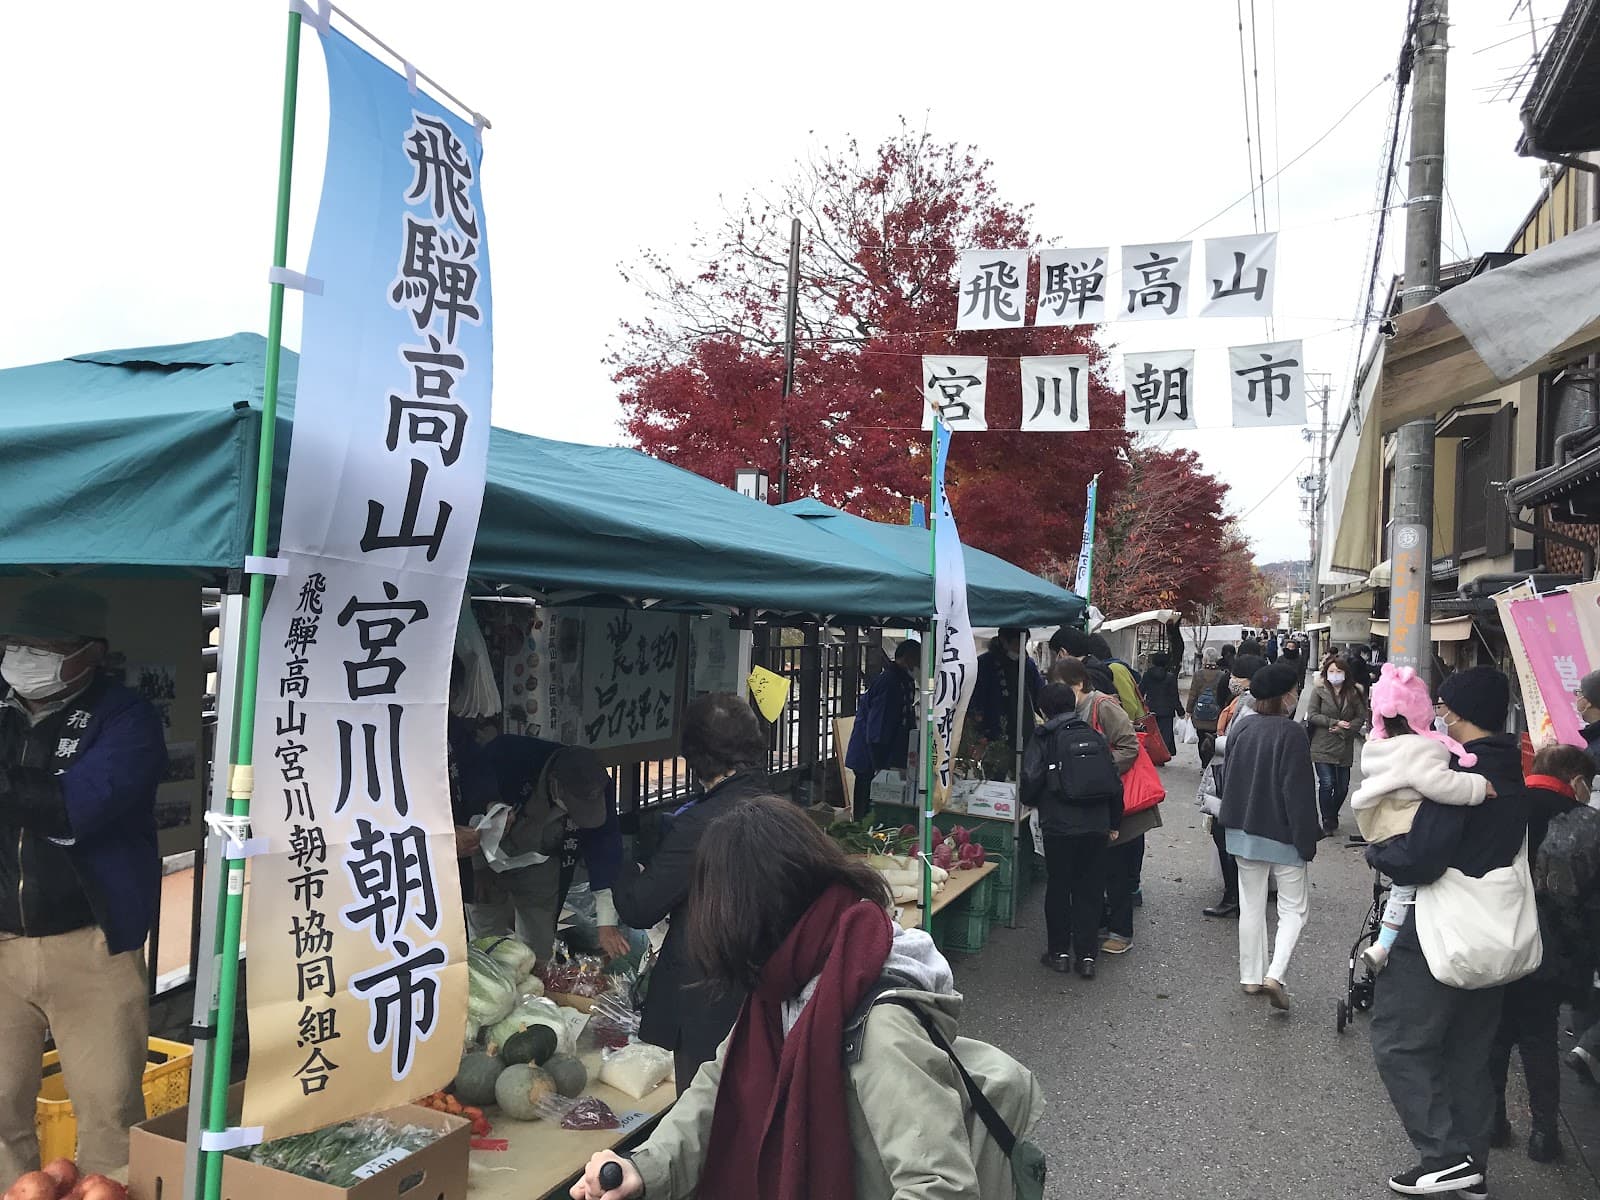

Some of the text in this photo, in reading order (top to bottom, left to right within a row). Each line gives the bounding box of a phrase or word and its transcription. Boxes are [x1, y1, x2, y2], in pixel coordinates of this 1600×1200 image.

[963, 251, 1268, 323] 飛騨高山
[928, 354, 1299, 425] 宮川朝市
[336, 113, 480, 1074] 飛騨高山宮川朝市
[55, 709, 92, 776] 飛騨
[275, 572, 340, 1096] 飛騨高山宮川朝市協同組合
